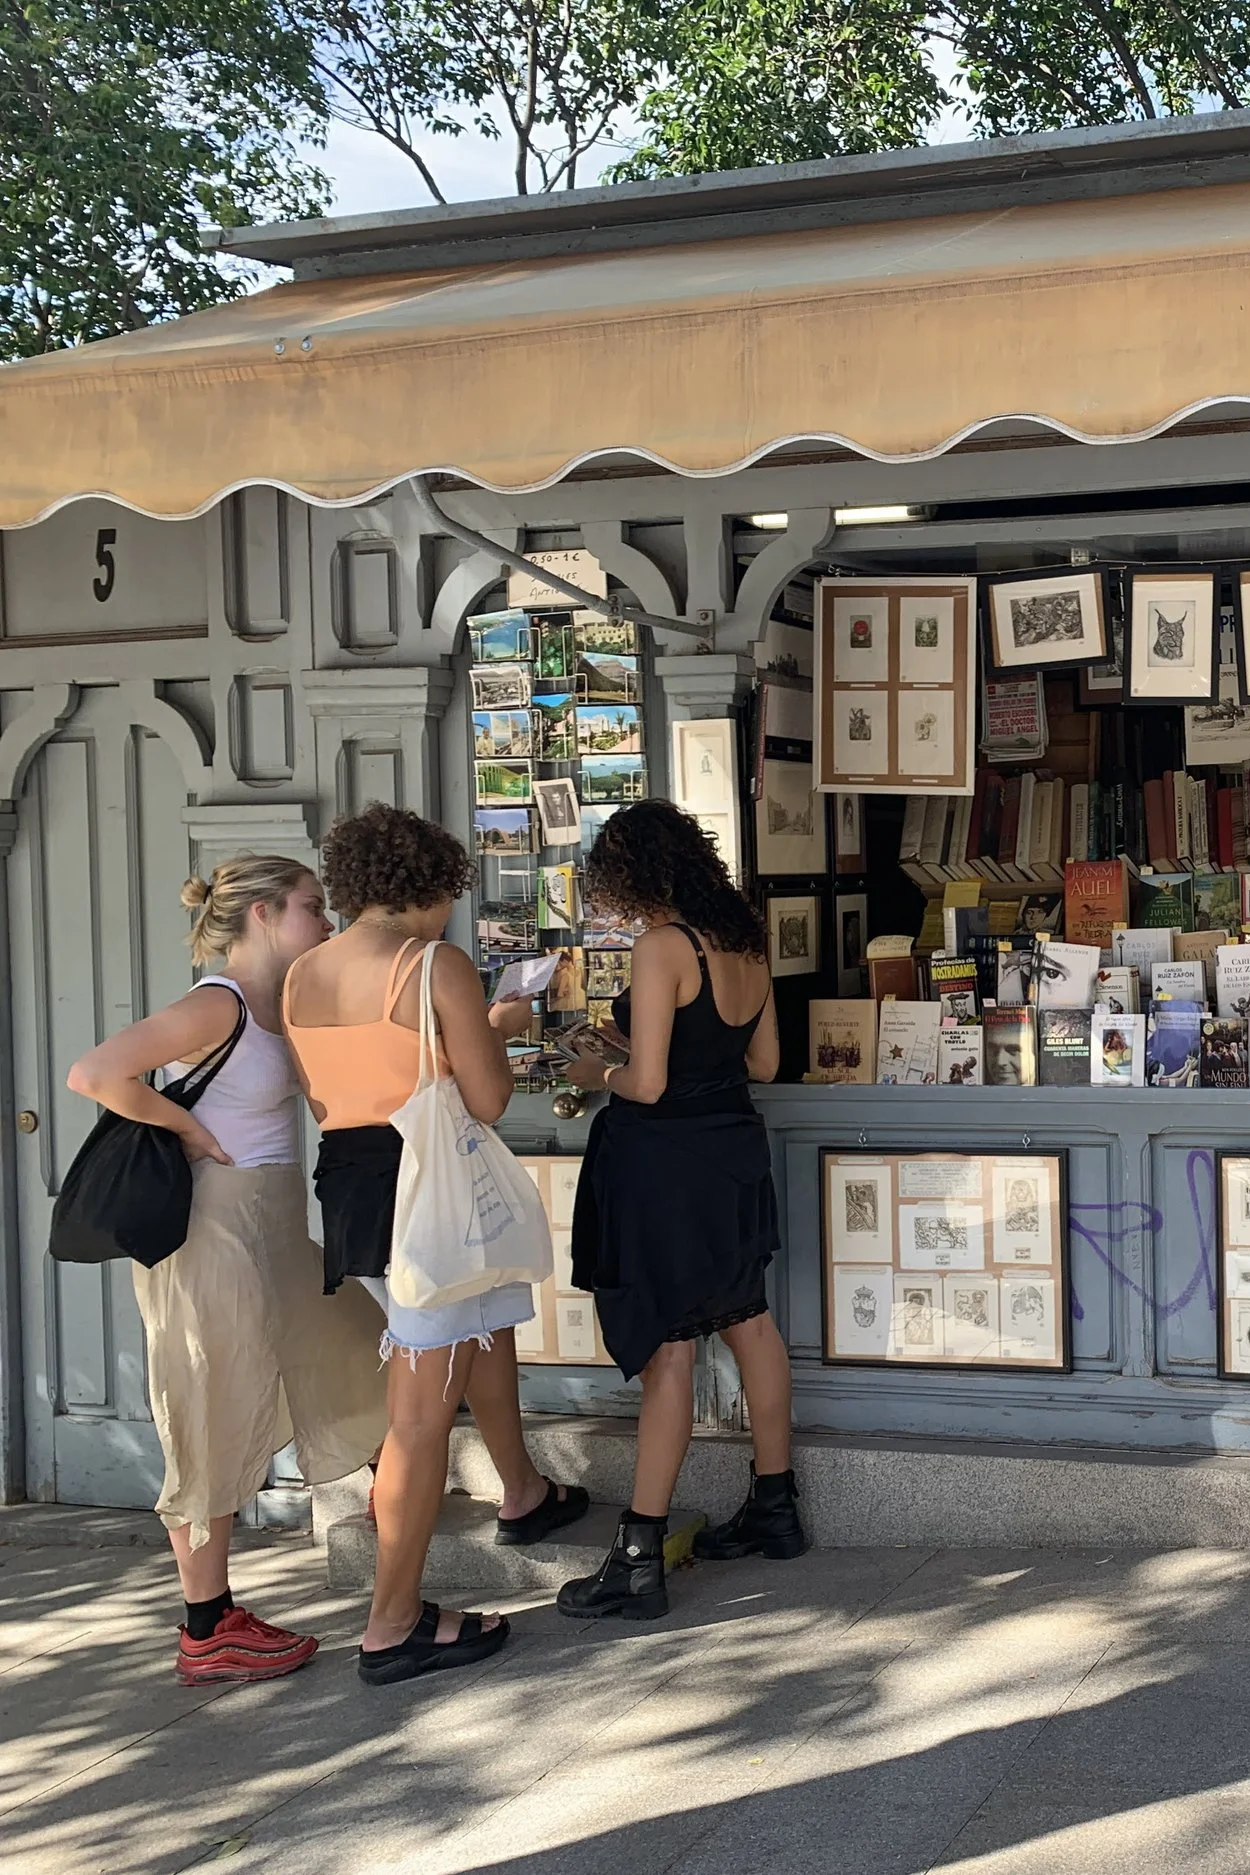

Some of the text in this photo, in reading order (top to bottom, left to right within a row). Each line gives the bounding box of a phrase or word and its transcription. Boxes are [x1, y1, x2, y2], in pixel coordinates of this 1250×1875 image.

[93, 528, 116, 602] 5
[1071, 867, 1099, 881] JEAN
[1070, 882, 1116, 896] AUEL
[1149, 908, 1182, 917] JULIAN
[1144, 919, 1188, 927] FELLOWES
[931, 964, 978, 981] NOSTRADAMUS
[1223, 966, 1244, 974] RUIZ
[1211, 1070, 1247, 1083] MUNDO
